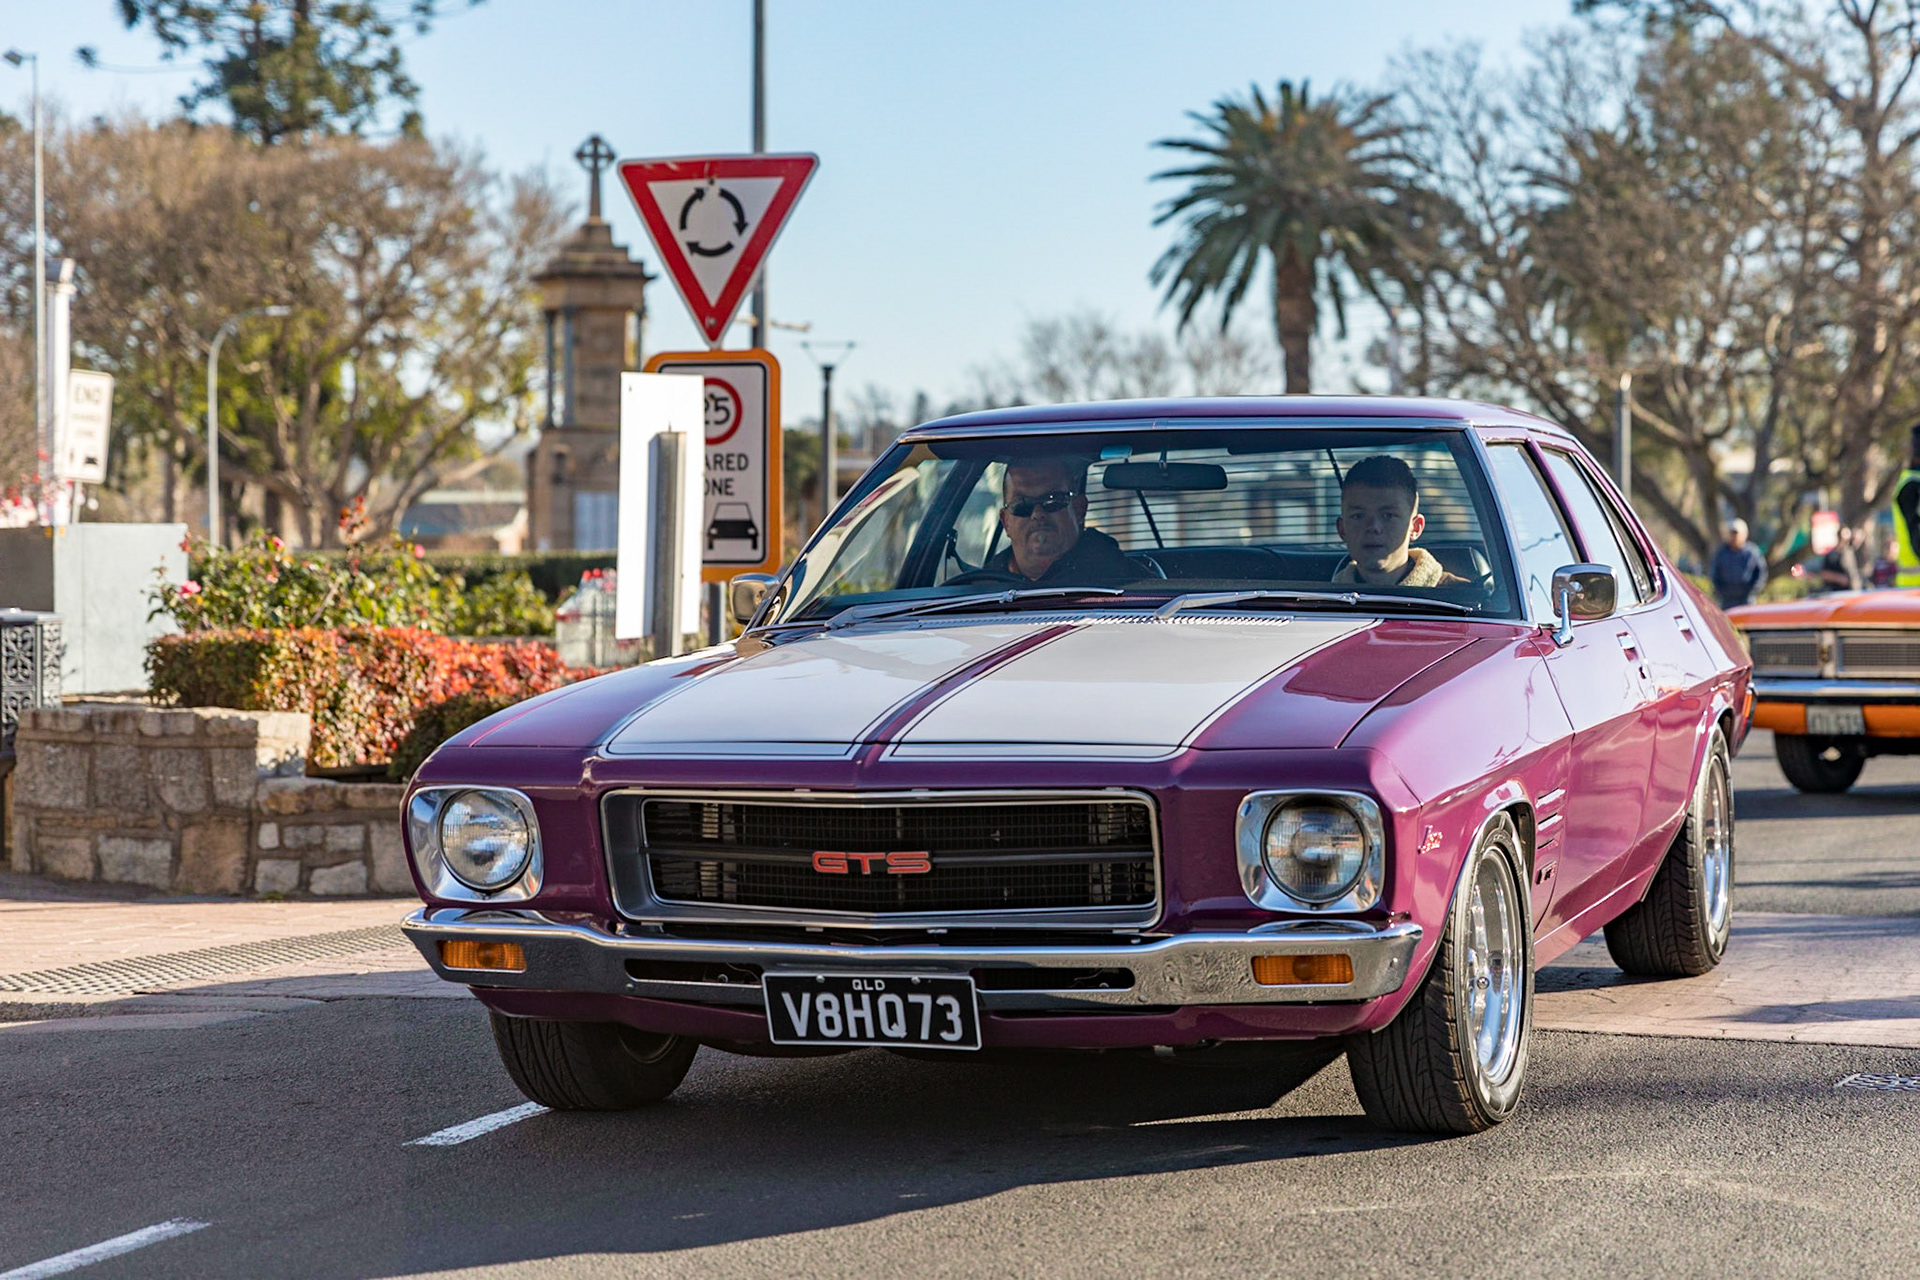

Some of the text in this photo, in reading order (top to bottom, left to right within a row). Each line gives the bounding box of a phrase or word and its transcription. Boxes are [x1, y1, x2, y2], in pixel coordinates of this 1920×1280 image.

[812, 851, 932, 875] GTS
[852, 979, 886, 991] QLD
[781, 992, 964, 1042] V8HQ73
